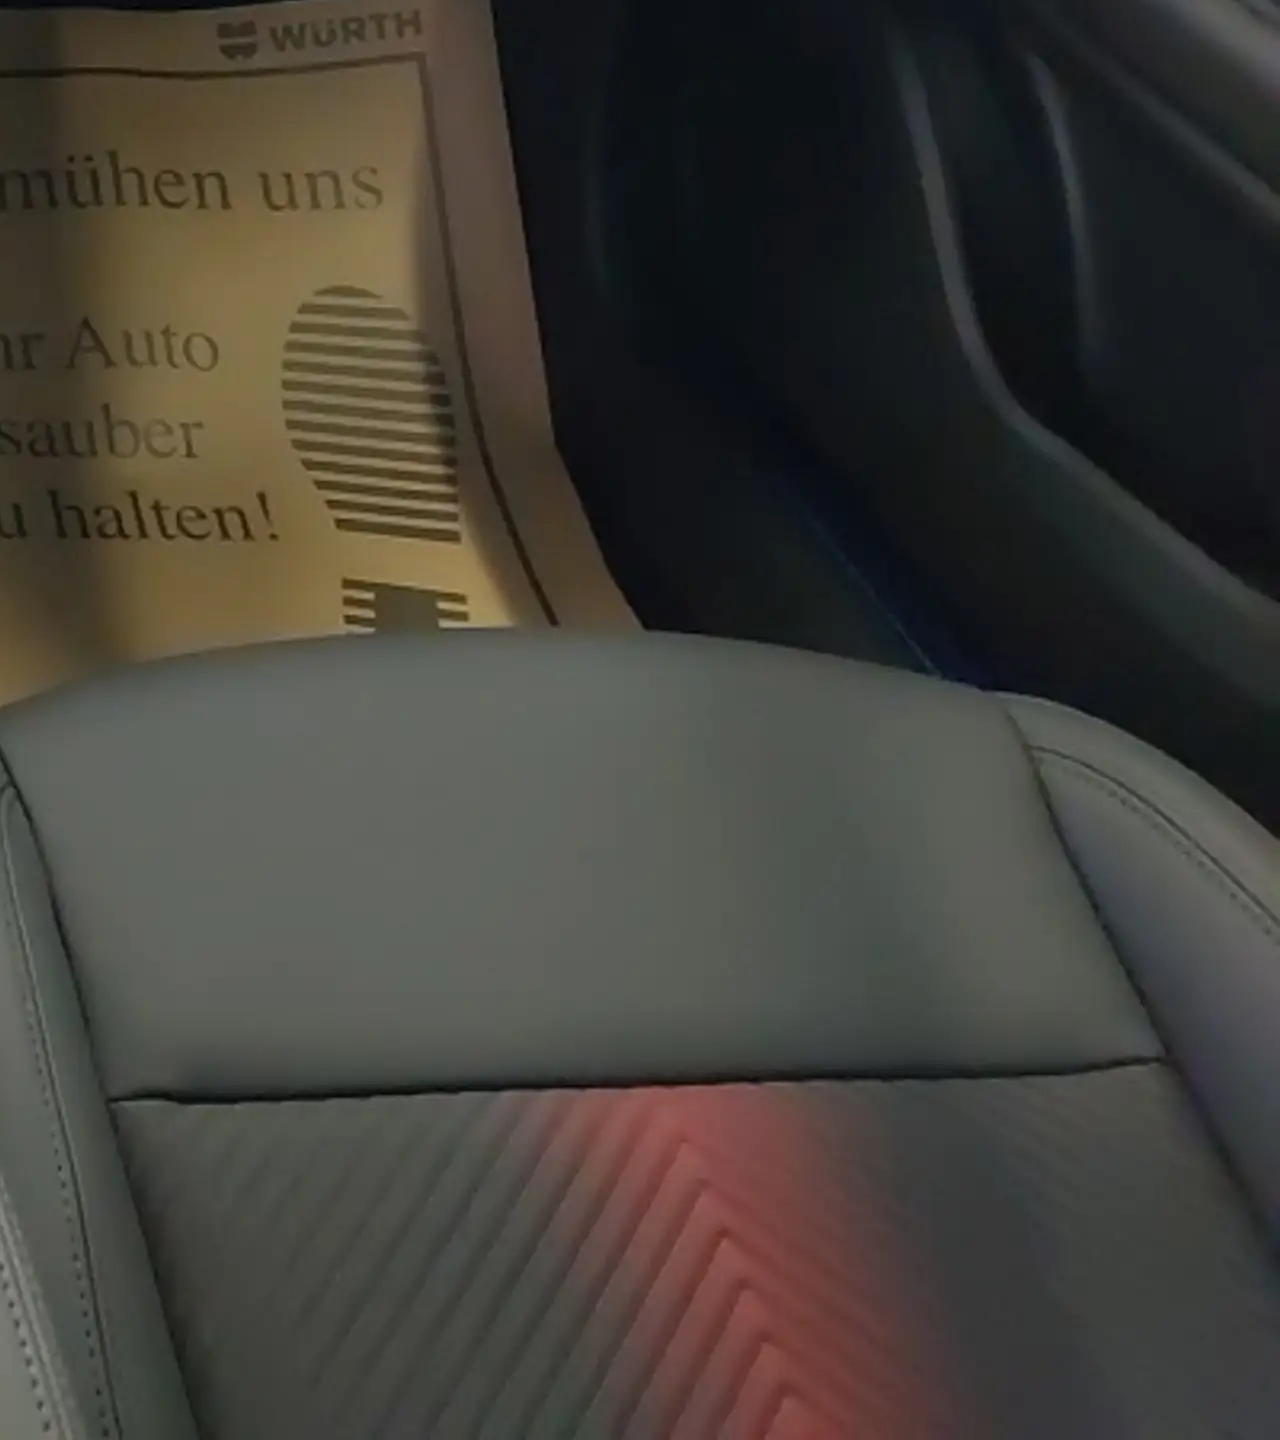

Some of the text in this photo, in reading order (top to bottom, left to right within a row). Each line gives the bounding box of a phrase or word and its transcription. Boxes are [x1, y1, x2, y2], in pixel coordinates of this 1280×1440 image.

[269, 9, 423, 53] WÜRTH
[259, 165, 384, 212] uns
[64, 315, 220, 372] Auto
[46, 488, 280, 542] halten!
